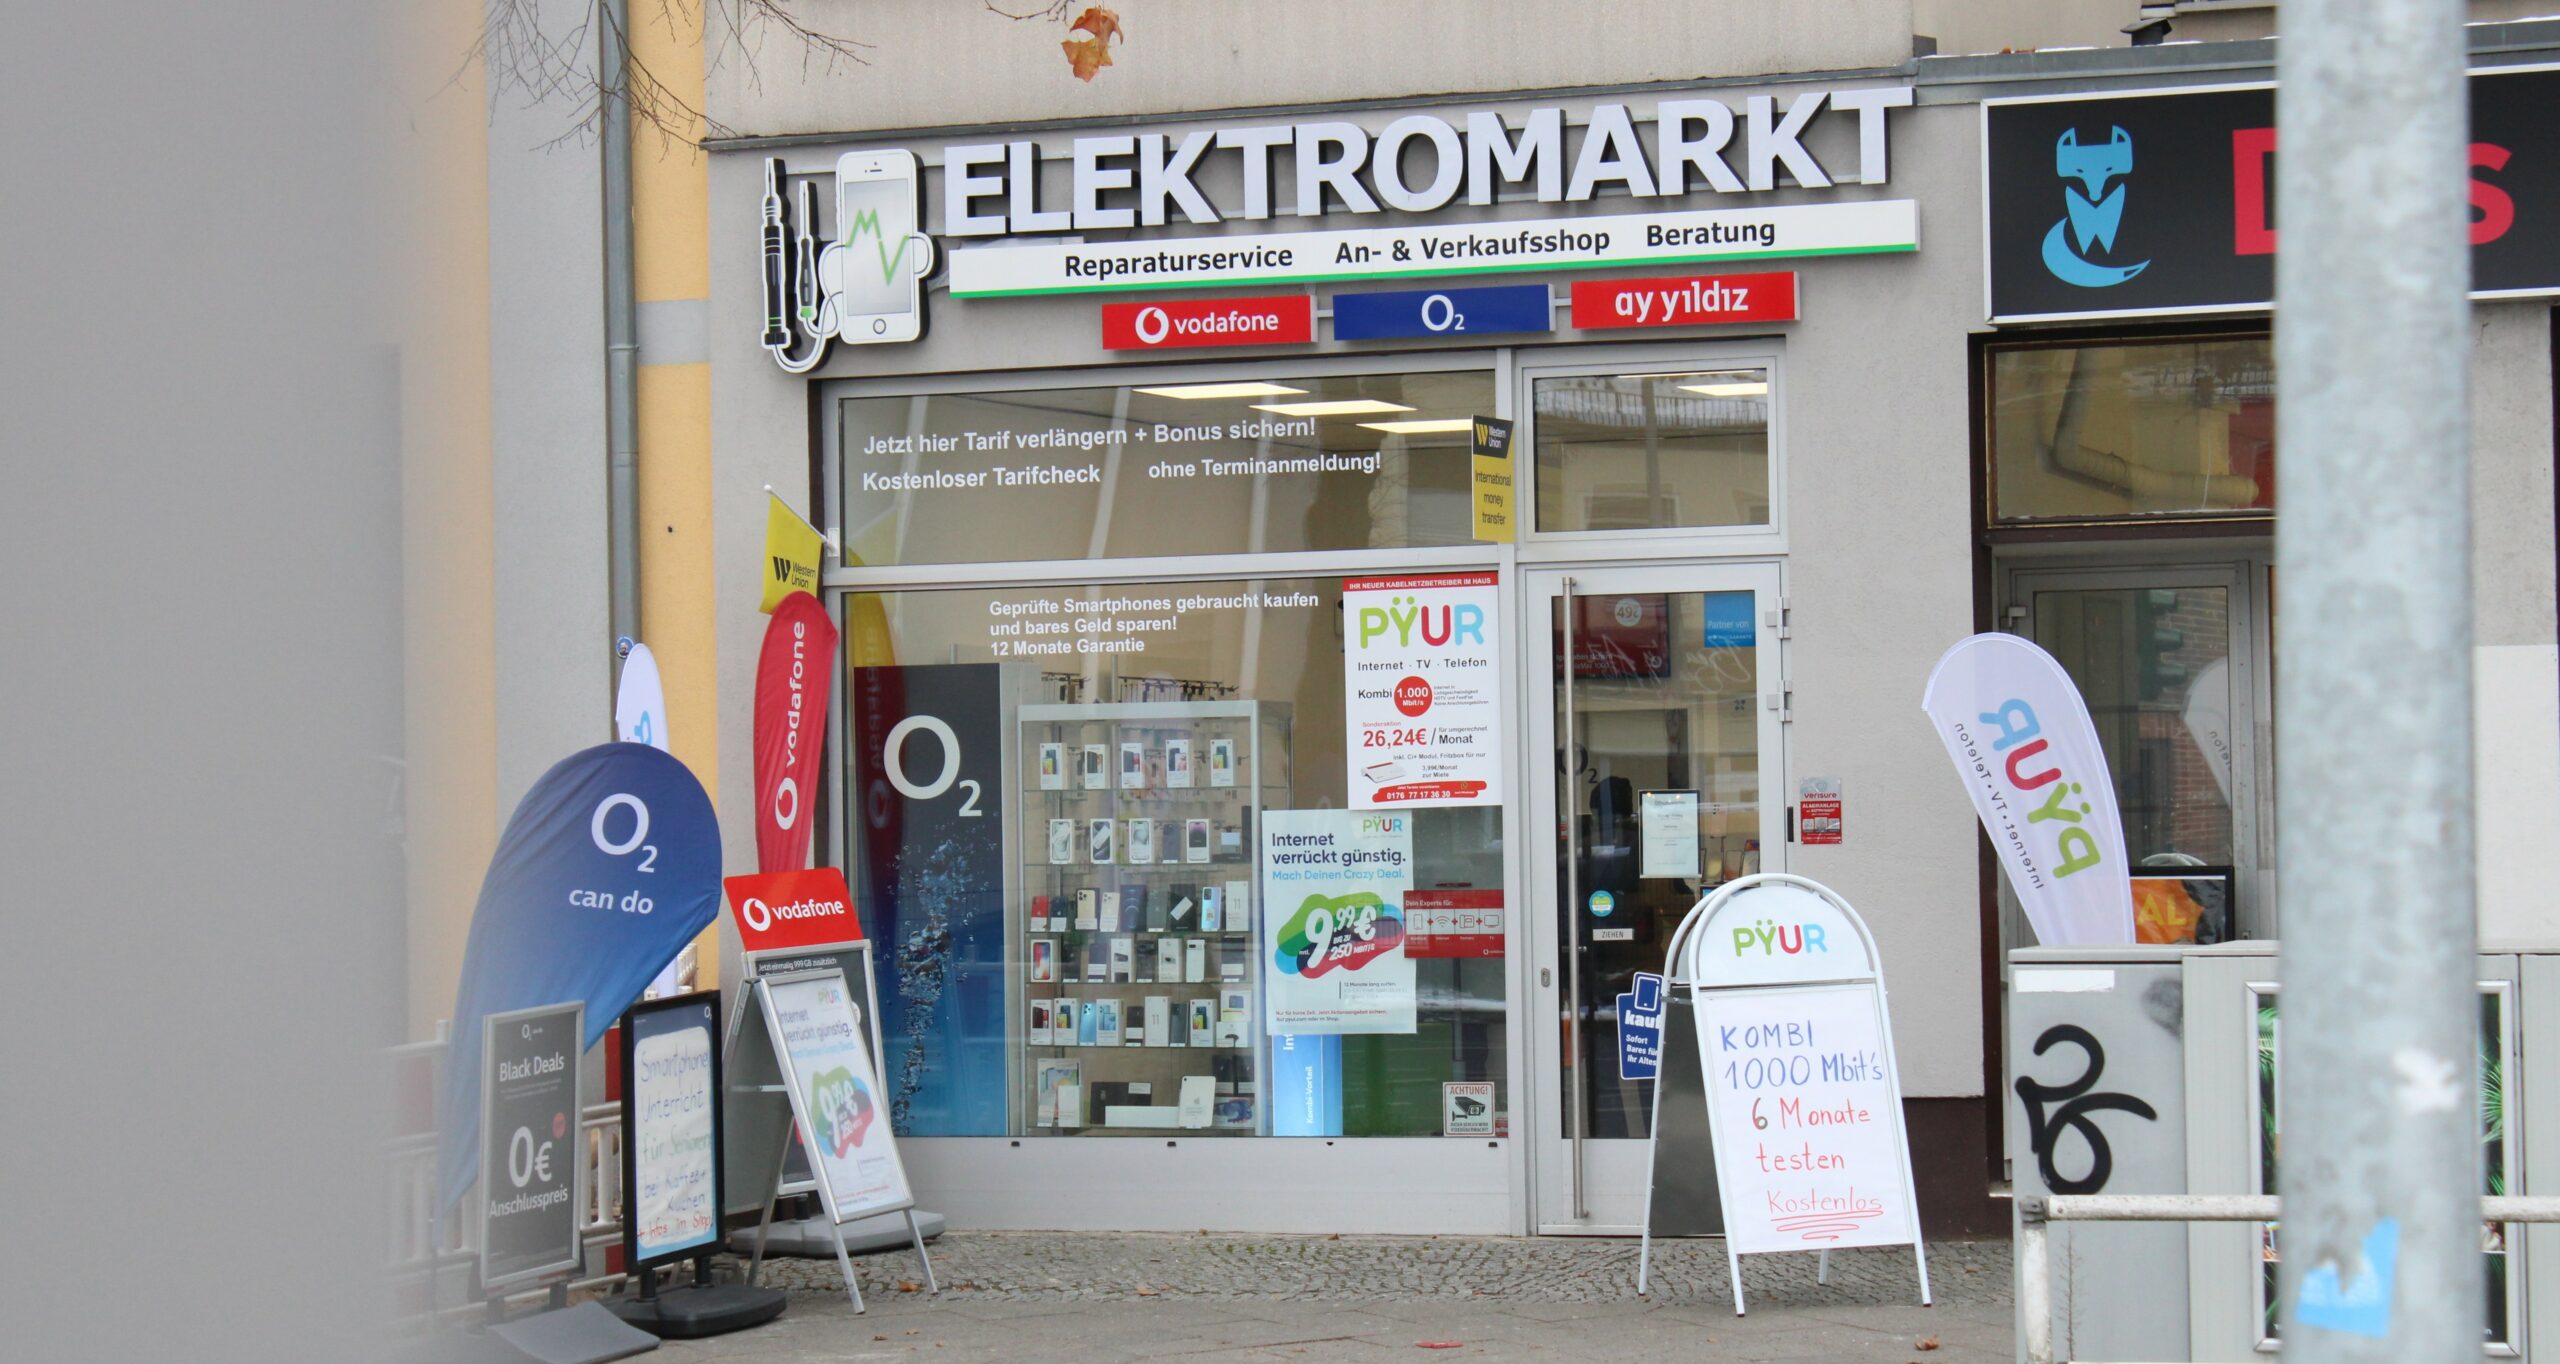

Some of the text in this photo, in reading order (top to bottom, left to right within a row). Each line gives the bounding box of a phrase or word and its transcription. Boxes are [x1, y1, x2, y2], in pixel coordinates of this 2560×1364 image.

[944, 86, 1917, 237] ELEKTROMARKT
[1064, 220, 1776, 280] Reparaturservice An- & Verkaufsshop Beratung
[1614, 291, 1653, 321] ay
[1173, 309, 1279, 335] vodafone
[863, 416, 1316, 455] Jetzt hier Tarif verlängern + Bonus sichern!
[1488, 425, 1507, 438] Western
[1488, 438, 1502, 449] Union
[862, 451, 1382, 491] Kostenloser Tarifcheck ohne Terminanmeldung!
[1475, 471, 1512, 487] International
[1483, 493, 1504, 508] money
[1482, 512, 1506, 526] transfer
[792, 560, 816, 579] Western
[791, 573, 809, 589] Union
[1473, 577, 1491, 585] HAUS
[989, 592, 1319, 618] Geprüfte Smartphones gebraucht kaufen
[990, 615, 1177, 636] und bares Geld sparen!
[1359, 596, 1485, 649] PŸUR
[991, 637, 1145, 656] 12 Monate Garantie
[1358, 657, 1487, 671] Internet TV Telefon
[785, 620, 806, 768] vodafone
[1358, 688, 1393, 700] Kombi
[1402, 699, 1425, 707] Mbit/s
[1397, 687, 1429, 699] 1.000
[1363, 728, 1428, 749] 26,24€
[1439, 733, 1473, 744] Monat
[1362, 816, 1403, 833] PŸUR
[1271, 832, 1335, 847] Internet
[1271, 848, 1407, 867] verrückt günstig.
[1272, 868, 1405, 882] Mach Deinen Crazy Deal.
[568, 888, 654, 915] can do
[771, 898, 846, 921] vodafone
[1601, 930, 1624, 939] ZIEHEN
[1733, 919, 1828, 957] PŸUR
[1329, 942, 1353, 961] 250
[1625, 1034, 1648, 1045] Sofort
[1719, 1019, 1814, 1051] KOMBI
[1626, 1044, 1647, 1055] Bares
[1627, 1054, 1638, 1063] Ihr
[499, 1051, 565, 1082] Black Deals
[1724, 1055, 1811, 1089] 1000
[1305, 1065, 1314, 1125] Kombi-Vorteil
[1449, 1085, 1489, 1095] ACHTUNG!
[1752, 1096, 1871, 1130] 6 Monate
[1755, 1142, 1845, 1173] testen
[488, 1184, 568, 1219] Anschlusspreis
[1768, 1187, 1883, 1213] Kostenlos
